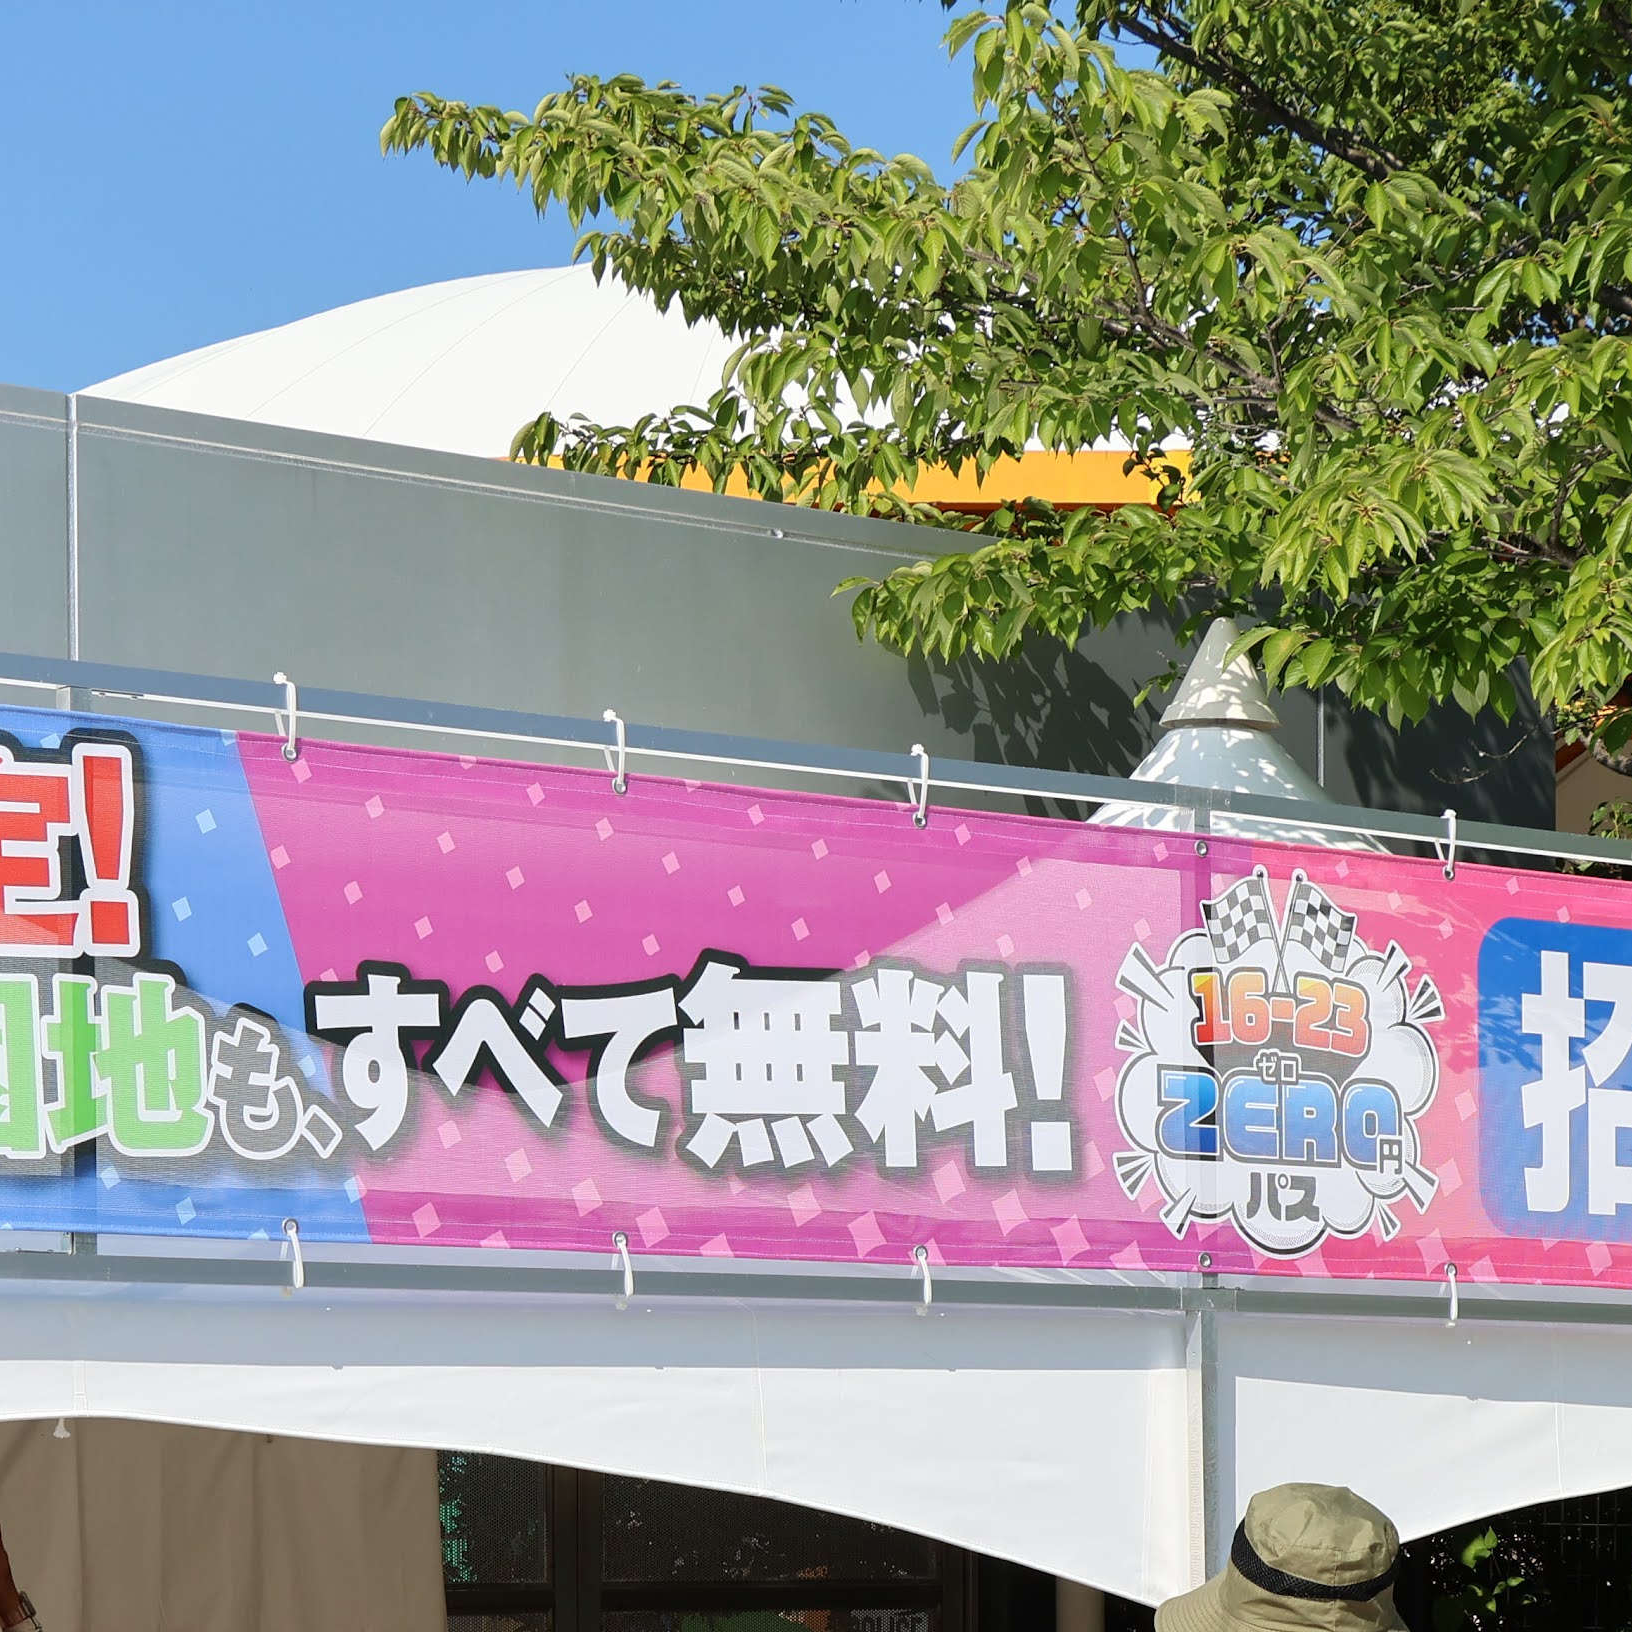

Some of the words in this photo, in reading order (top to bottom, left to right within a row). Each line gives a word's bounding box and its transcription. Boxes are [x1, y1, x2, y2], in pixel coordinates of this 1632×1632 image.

[1190, 969, 1369, 1058] 16-23
[1258, 1054, 1298, 1083] ゼロ
[1246, 1172, 1321, 1222] パス
